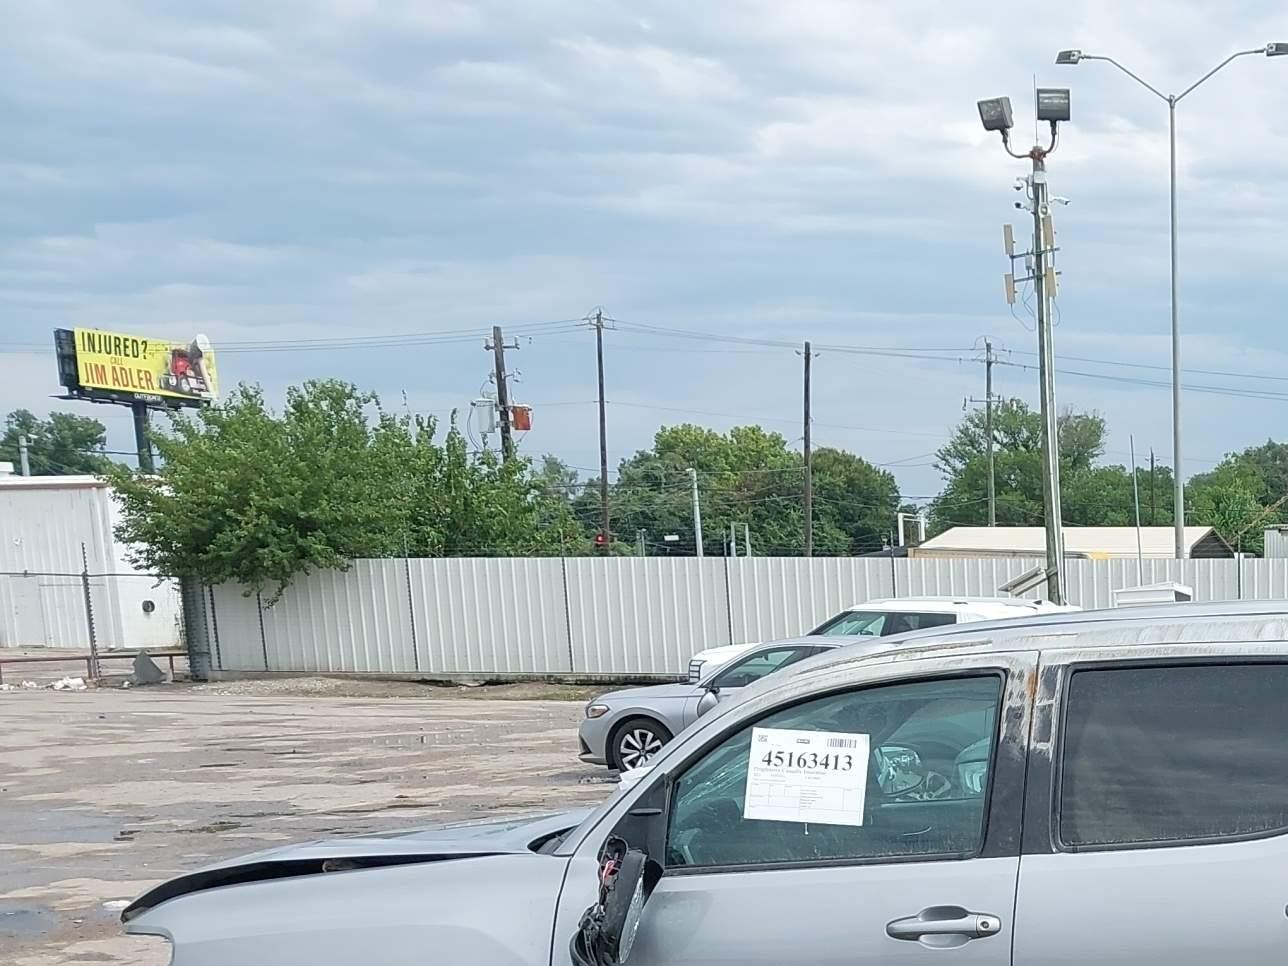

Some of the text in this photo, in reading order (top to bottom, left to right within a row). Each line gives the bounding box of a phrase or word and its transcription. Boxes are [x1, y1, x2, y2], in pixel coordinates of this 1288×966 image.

[81, 332, 149, 360] INJURED?
[109, 356, 123, 366] CALL
[83, 362, 155, 391] JIM ADLER
[761, 750, 853, 772] 45163413
